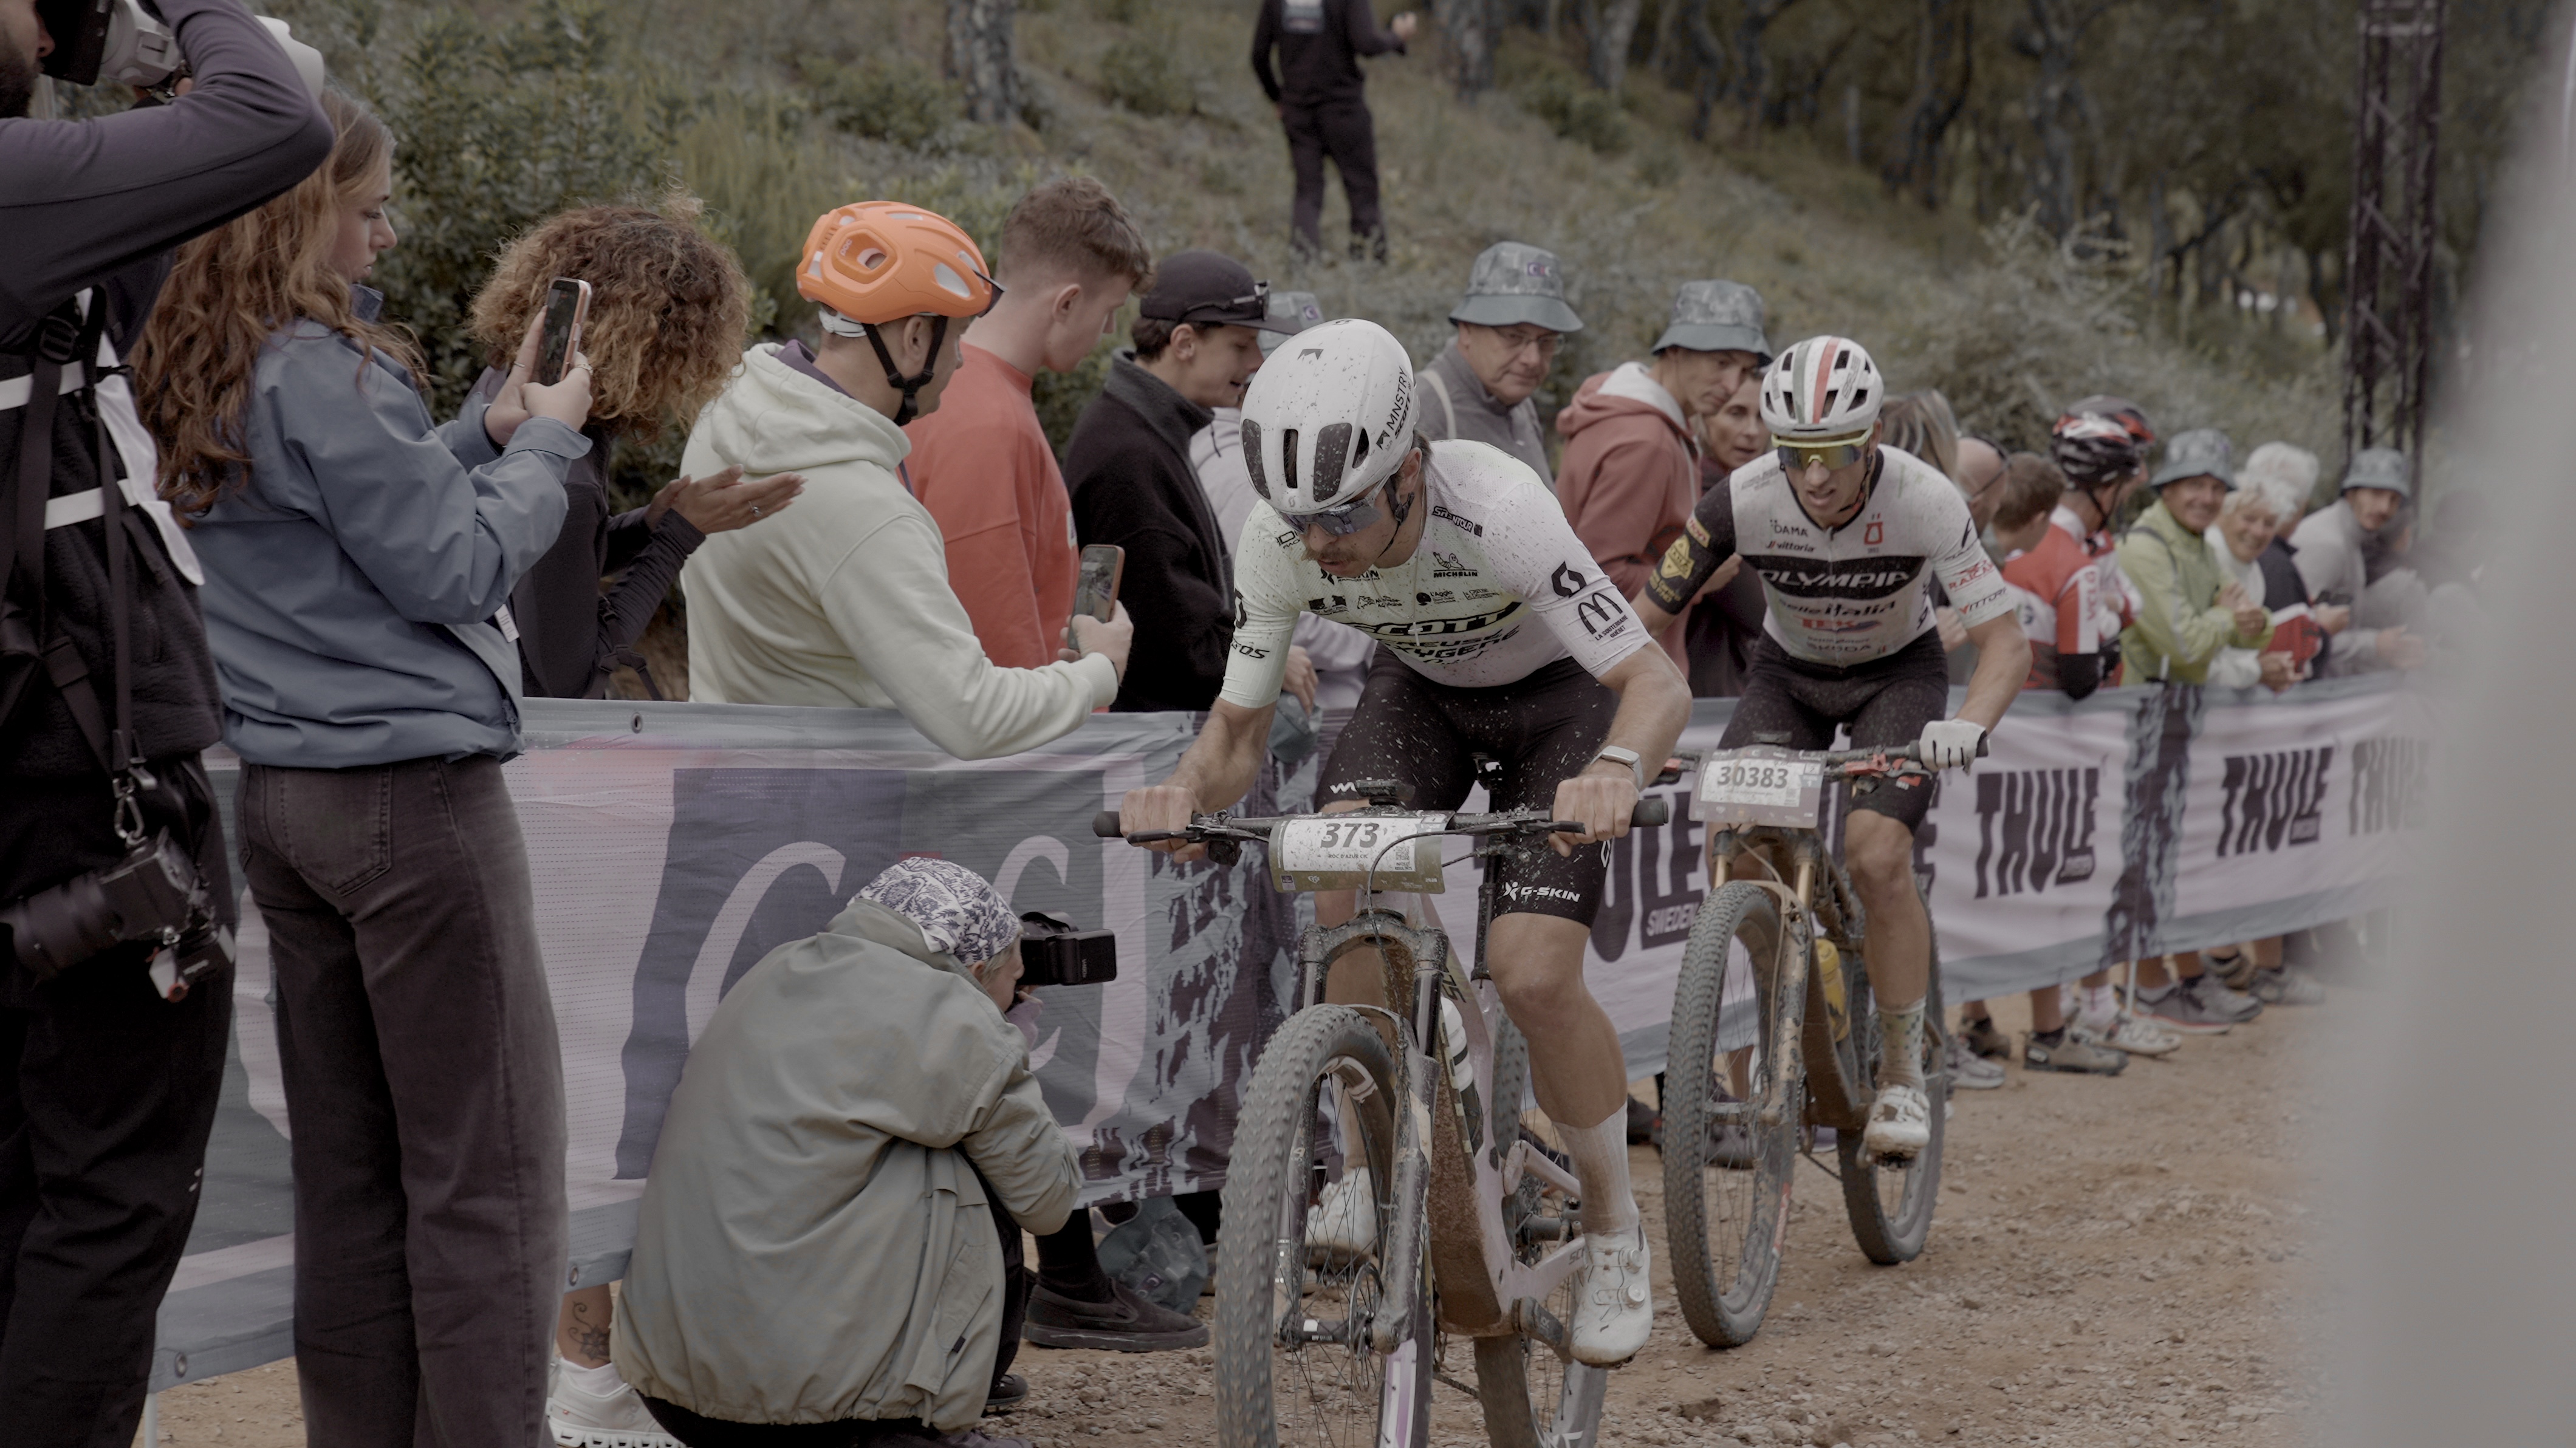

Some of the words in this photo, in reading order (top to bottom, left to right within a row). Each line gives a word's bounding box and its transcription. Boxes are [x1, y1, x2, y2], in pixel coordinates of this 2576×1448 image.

[840, 239, 852, 256] poc
[1774, 524, 1809, 538] DAMA
[1776, 540, 1816, 553] vittoria
[1758, 569, 1910, 589] OLYMPIA
[1824, 600, 1895, 618] italia
[1385, 626, 1519, 658] XYGENE
[1717, 766, 1789, 789] 30383
[2217, 747, 2334, 857] THULE
[1320, 822, 1380, 848] 373
[1975, 767, 2099, 899] THULE
[1520, 886, 1581, 903] G-SKIN
